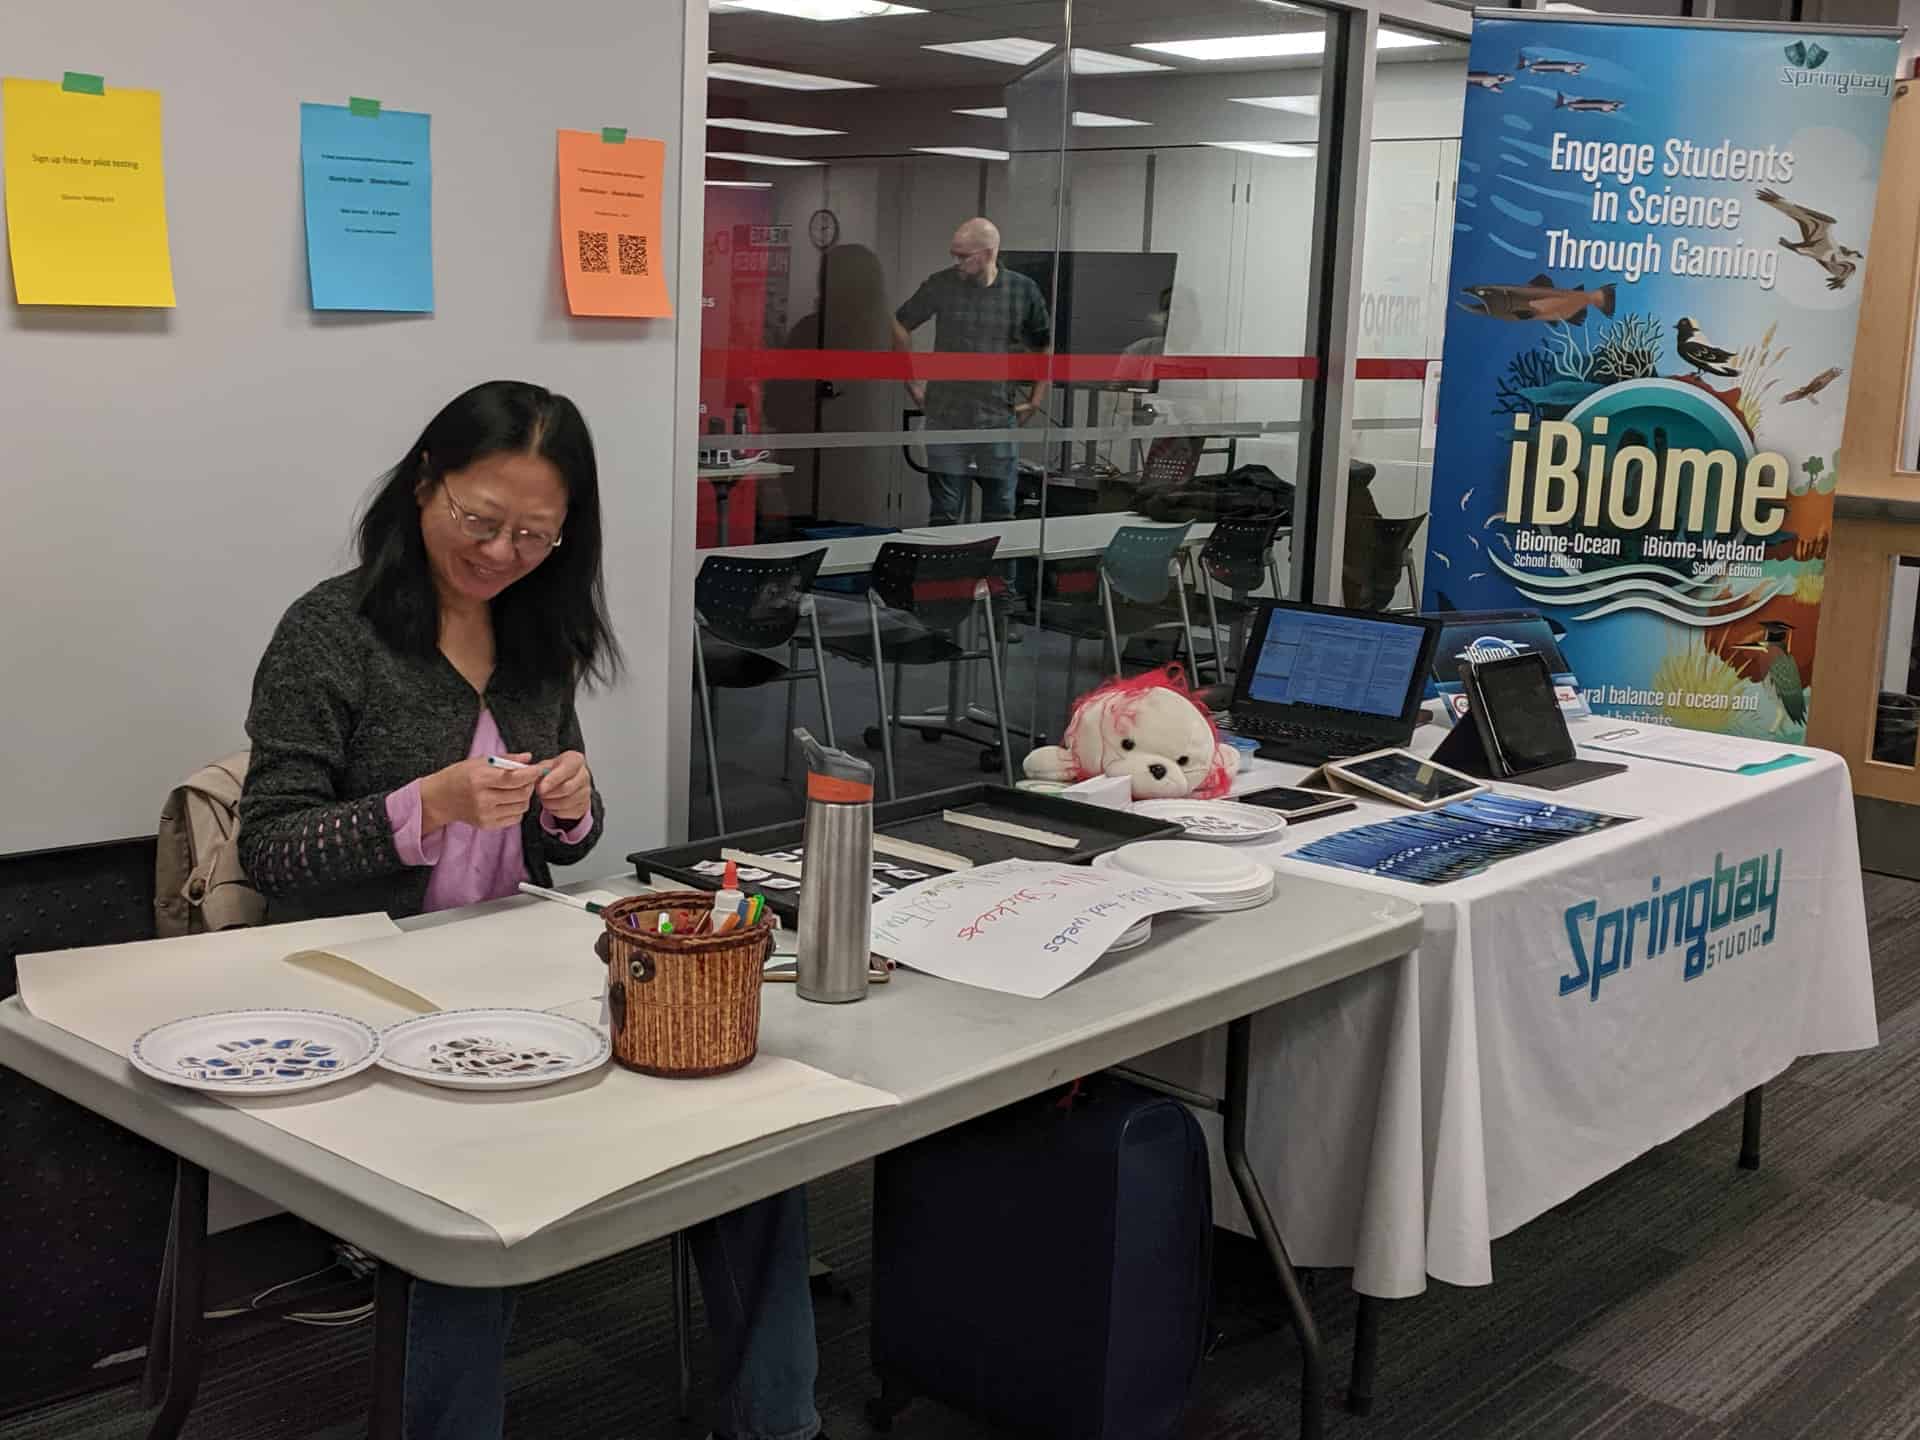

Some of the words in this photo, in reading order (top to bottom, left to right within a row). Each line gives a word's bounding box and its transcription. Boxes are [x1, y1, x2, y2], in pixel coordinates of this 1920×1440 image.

[1781, 66, 1890, 97] Springbay
[1551, 131, 1655, 184] Engage
[1663, 137, 1796, 184] Students
[1591, 182, 1619, 222] in
[1627, 186, 1741, 230] Science
[1546, 229, 1661, 283] Through
[1671, 236, 1779, 291] Gaming
[1504, 412, 1791, 537] iBiome
[1513, 554, 1548, 568] School
[1549, 556, 1583, 569] Edition
[1515, 530, 1621, 556] iBiome-Ocean
[1643, 535, 1766, 562] iBiome-Wetland
[1691, 560, 1726, 576] School
[1728, 562, 1763, 577] Edition
[1609, 684, 1664, 707] balance
[1668, 687, 1685, 707] of
[1685, 693, 1729, 711] ocean
[1731, 692, 1760, 711] and
[1558, 848, 1784, 1002] Springbay
[1706, 924, 1762, 969] STUDIO
